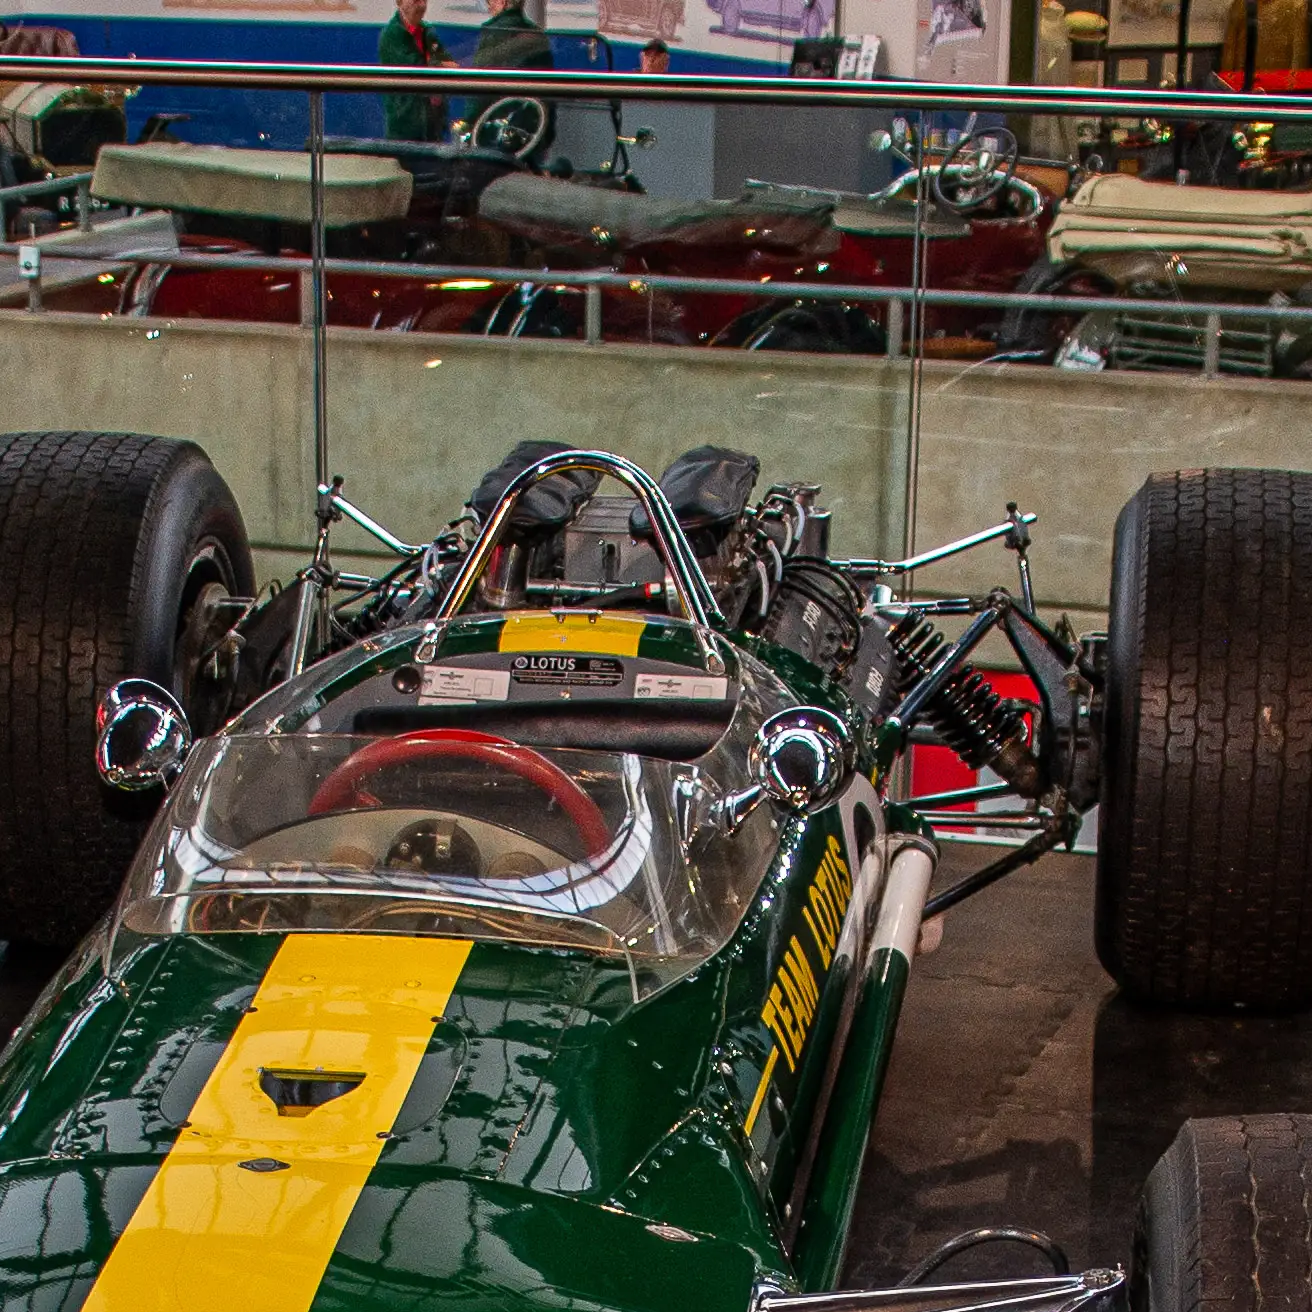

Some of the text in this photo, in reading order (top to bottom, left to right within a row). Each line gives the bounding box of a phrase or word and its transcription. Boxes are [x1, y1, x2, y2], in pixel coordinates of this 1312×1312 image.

[530, 657, 577, 671] LOTUS
[761, 835, 853, 1073] TEAM LOTUS
